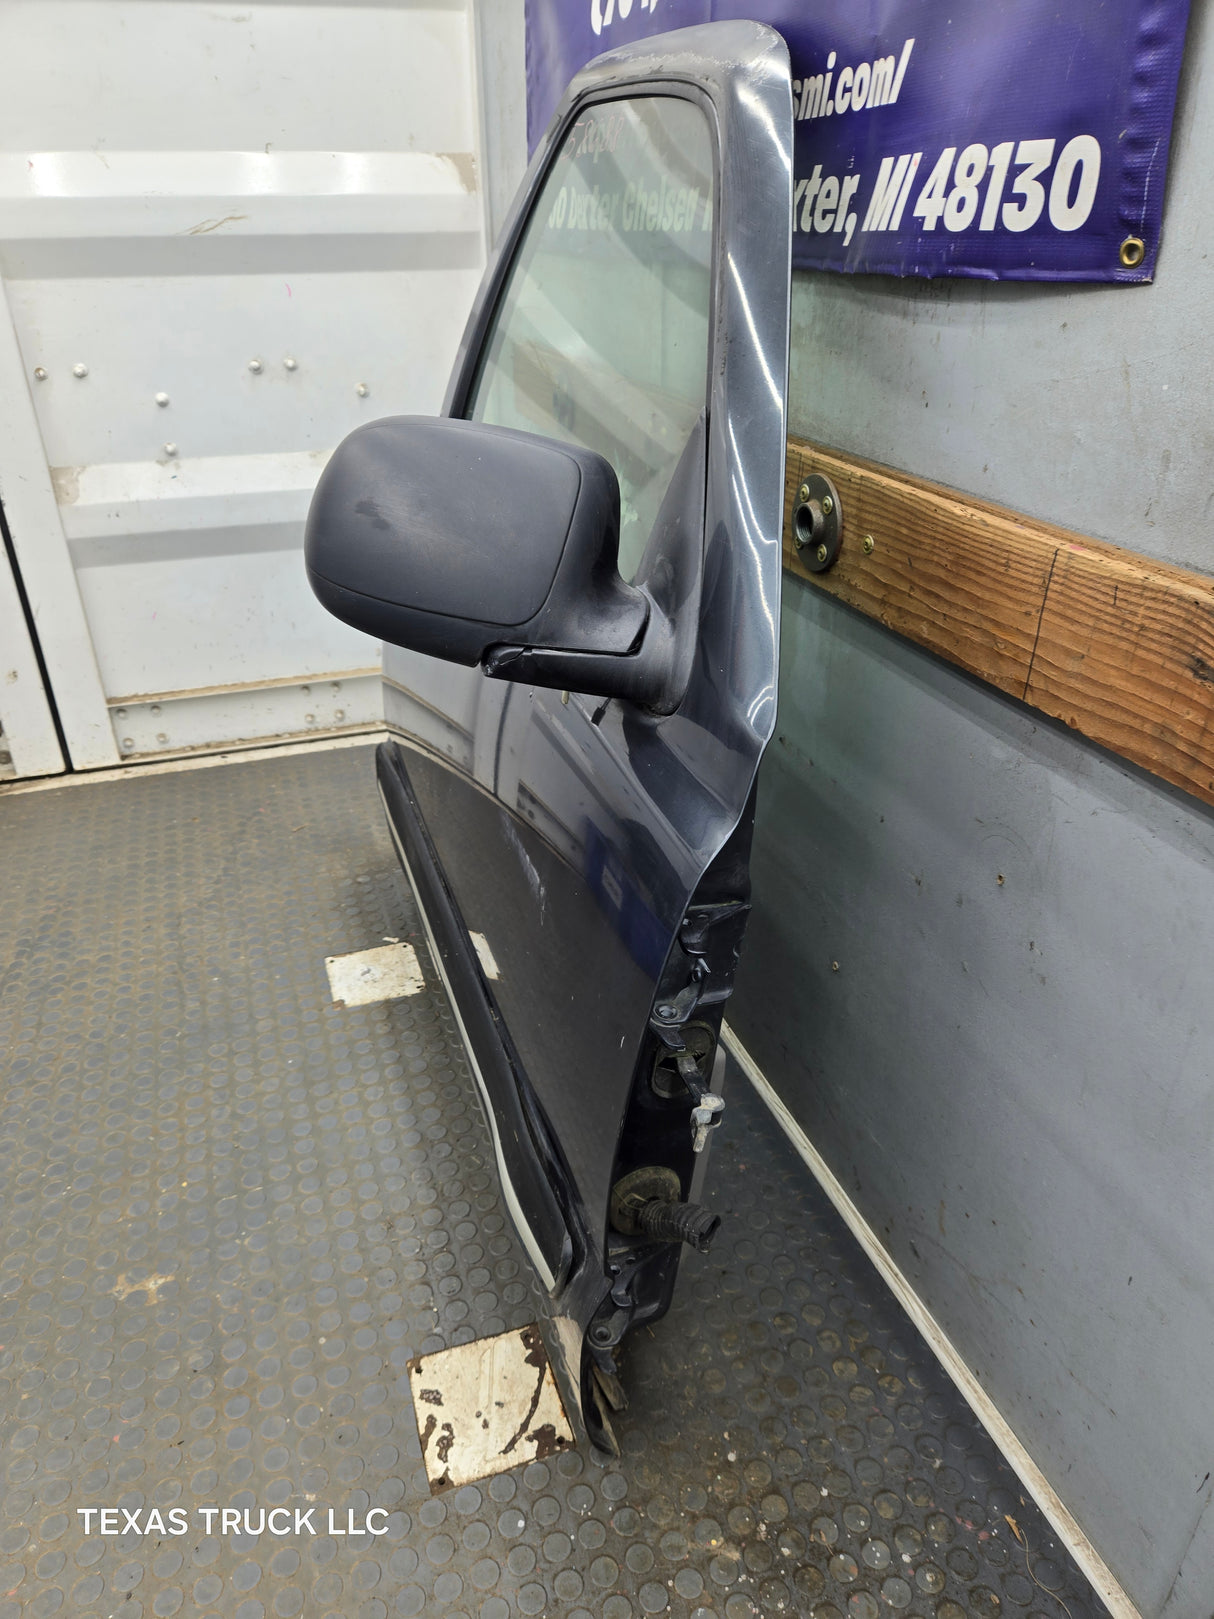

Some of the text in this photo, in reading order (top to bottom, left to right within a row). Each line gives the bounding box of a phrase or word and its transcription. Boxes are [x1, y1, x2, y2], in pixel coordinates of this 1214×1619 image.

[792, 38, 915, 121] smi.com/
[793, 164, 861, 246] xter,
[861, 152, 923, 232] MI
[913, 134, 1102, 233] 48130
